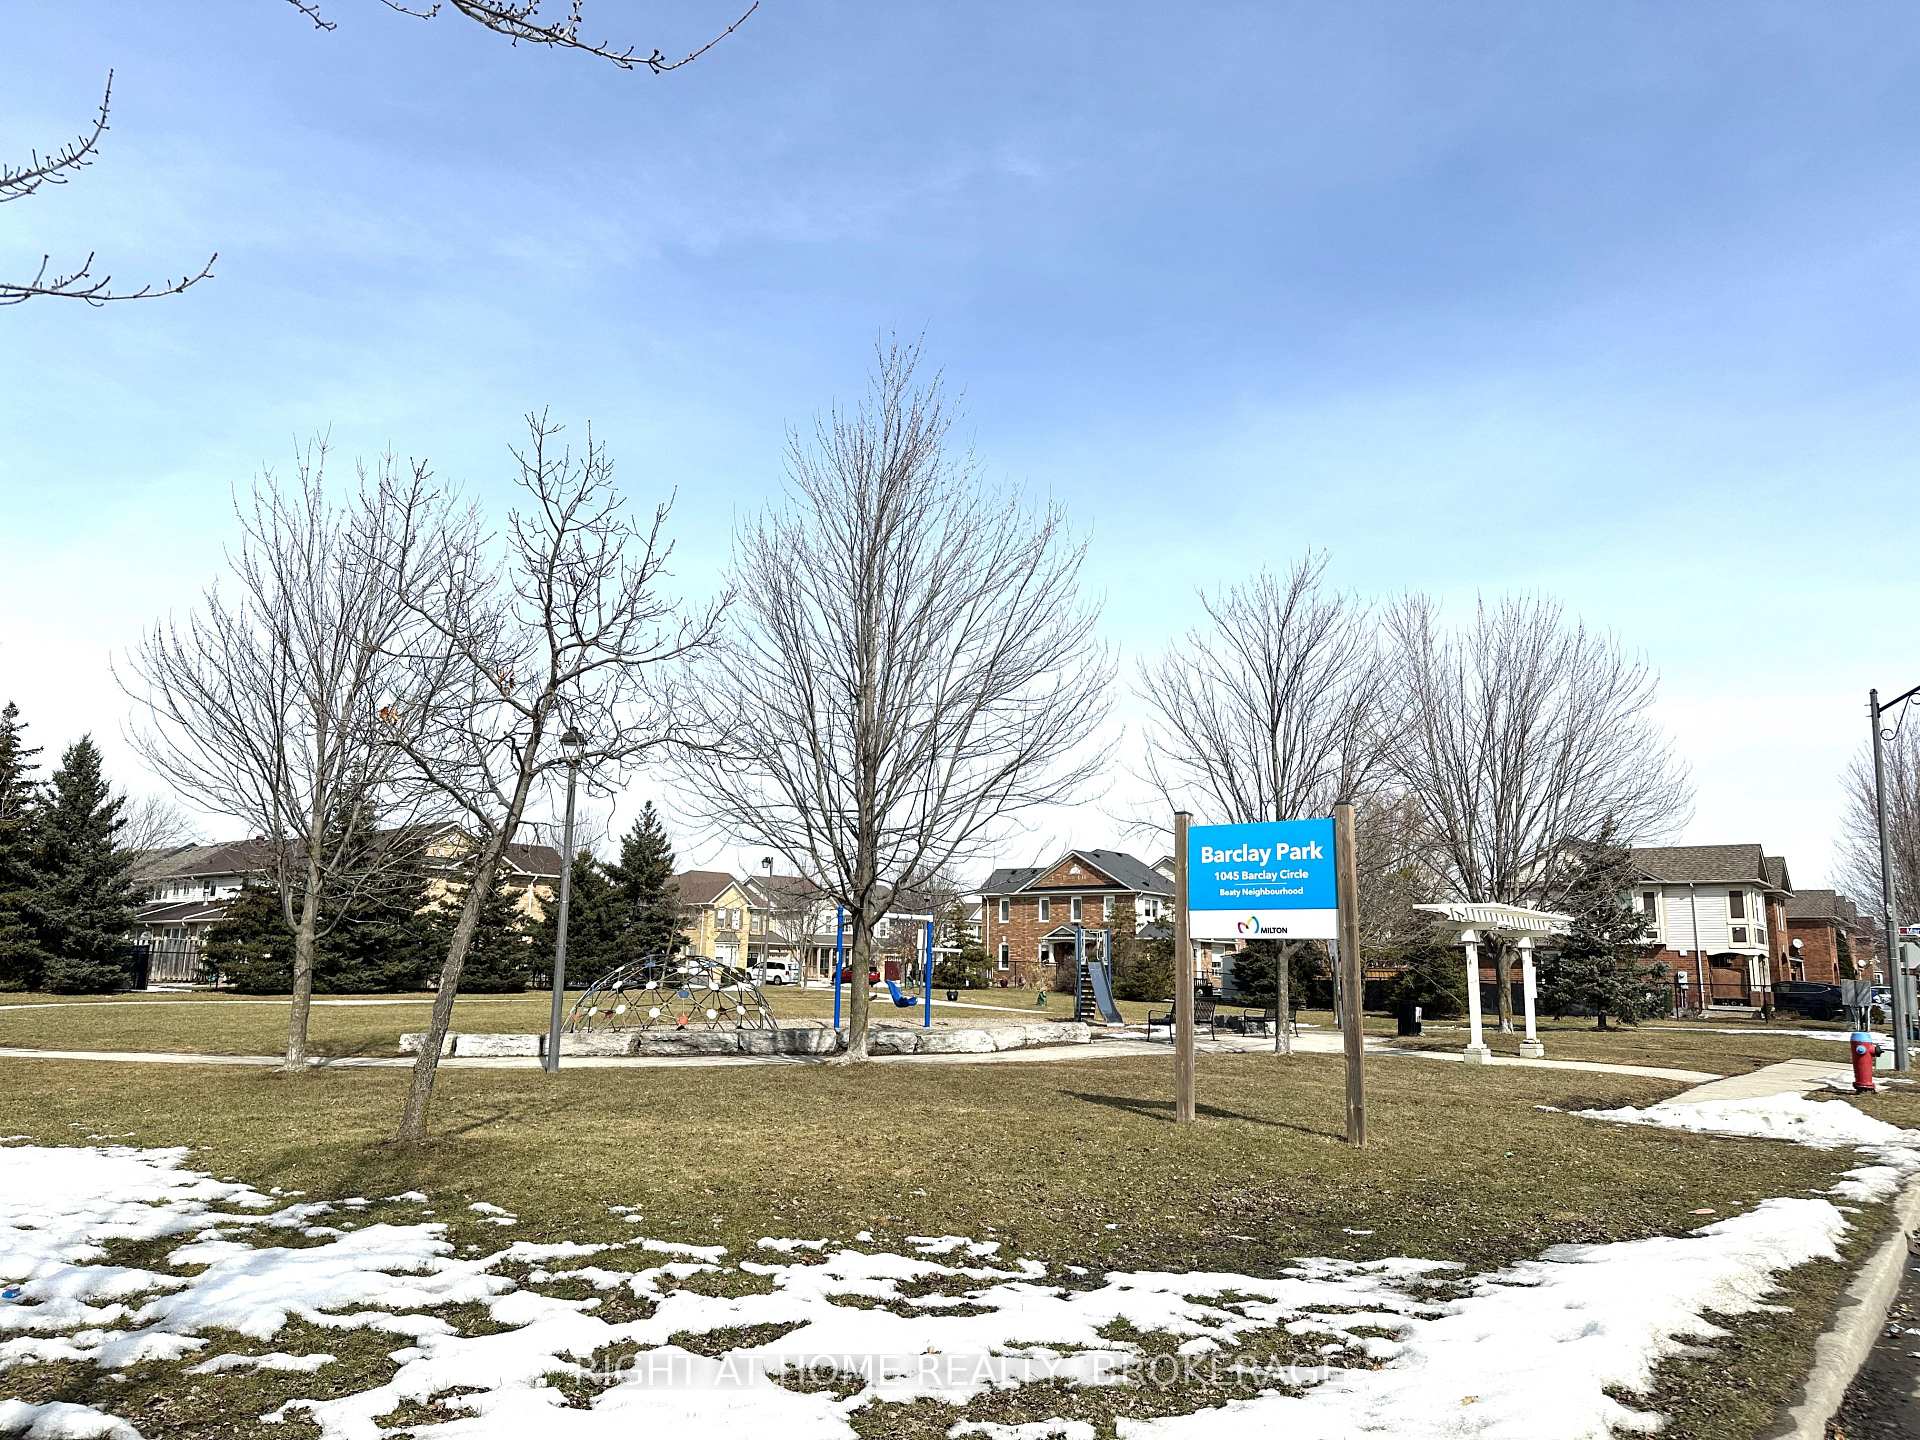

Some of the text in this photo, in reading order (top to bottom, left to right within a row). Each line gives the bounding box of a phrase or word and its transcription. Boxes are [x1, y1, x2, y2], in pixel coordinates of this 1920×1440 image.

[1201, 840, 1323, 867] Barclay Park
[1215, 868, 1309, 882] 1045 Barclay Circle
[1242, 886, 1304, 898] Neighbourhood
